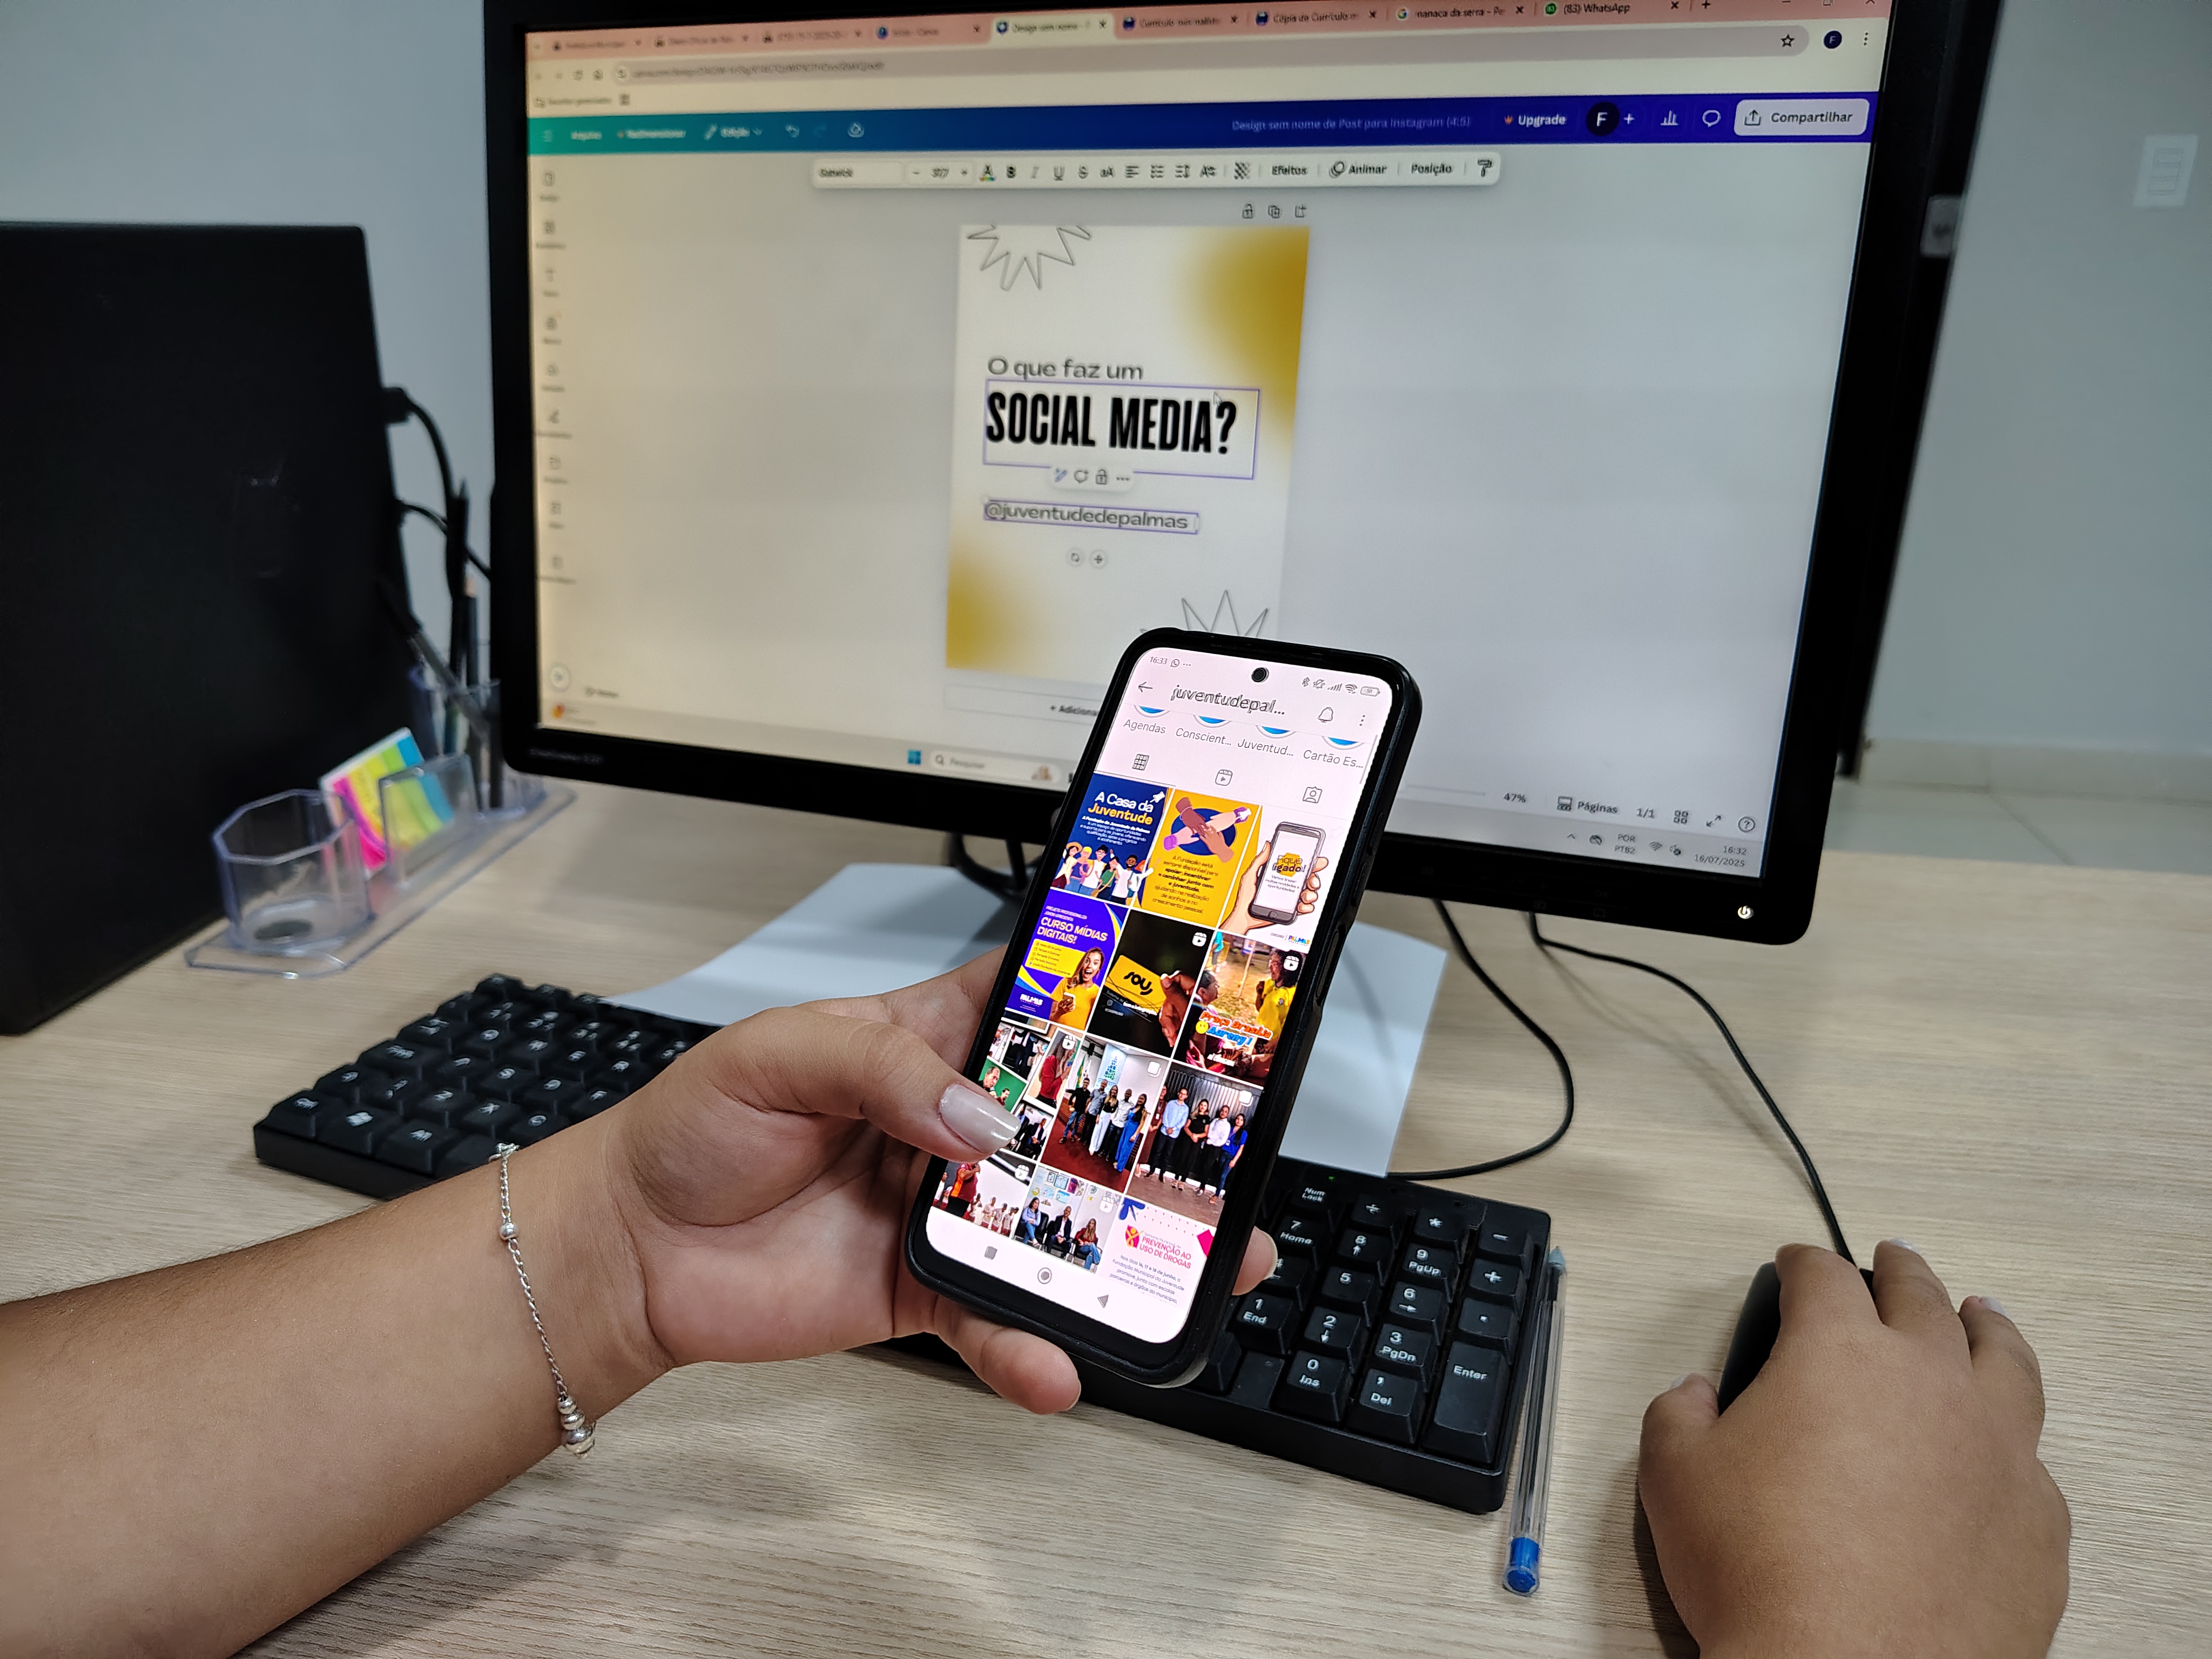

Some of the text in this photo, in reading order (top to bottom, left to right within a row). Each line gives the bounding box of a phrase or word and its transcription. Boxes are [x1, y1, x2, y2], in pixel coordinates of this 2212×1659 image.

[1583, 3, 1630, 14] WhatsApp
[1518, 113, 1567, 127] Upgrade
[1596, 112, 1608, 126] F
[1770, 111, 1854, 125] Compartilhar
[1271, 165, 1308, 176] Efeitos
[1348, 164, 1387, 174] Animar
[1411, 163, 1452, 177] Posição
[987, 358, 1144, 381] O que faz um
[986, 391, 1237, 454] SOCIAL MEDIA?
[984, 502, 1188, 530] @juventudedepalmas
[1149, 656, 1168, 665] 16:33
[1170, 684, 1285, 715] juventudepal...
[1123, 719, 1364, 768] Agendas Conscient... Juventud... Cartão Es...
[1095, 791, 1154, 812] A Casa da
[1503, 793, 1527, 804] 47%
[1088, 802, 1153, 825] Juventude
[1577, 800, 1618, 815] Páginas
[1636, 807, 1655, 819] 1/1
[1617, 834, 1636, 842] POR
[1615, 845, 1636, 854] PTB2
[1695, 854, 1745, 867] 16/07/2025
[1037, 926, 1078, 945] DIGITAIS!
[1041, 916, 1109, 941] CURSO MÍDIAS
[1288, 935, 1311, 945] PALMAS
[1200, 1011, 1231, 1027] Praça
[1206, 1027, 1247, 1046] Aureny
[1302, 1192, 1324, 1203] Lock
[1305, 1188, 1326, 1197] Num
[1291, 1220, 1301, 1230] 7
[1280, 1231, 1313, 1245] Home
[1355, 1235, 1367, 1246] 8
[1142, 1236, 1191, 1260] PREVENÇÃO AO
[1416, 1249, 1428, 1260] 9
[1129, 1257, 1138, 1265] dias
[1139, 1243, 1191, 1269] USO DE DROGAS
[1408, 1261, 1441, 1276] PgUp
[1134, 1267, 1155, 1279] Municipal
[1162, 1279, 1185, 1291] Juventude
[1136, 1276, 1148, 1284] junto
[1339, 1272, 1352, 1285] 5
[1404, 1287, 1417, 1300] 6
[1255, 1298, 1264, 1311] 1
[1243, 1311, 1268, 1325] End
[1323, 1315, 1337, 1329] 2
[1390, 1331, 1403, 1345] 3
[1381, 1345, 1417, 1363] PgDn
[1307, 1358, 1319, 1372] 0
[1453, 1364, 1488, 1381] Enter
[1299, 1374, 1321, 1389] Ins
[1371, 1392, 1393, 1406] Del
